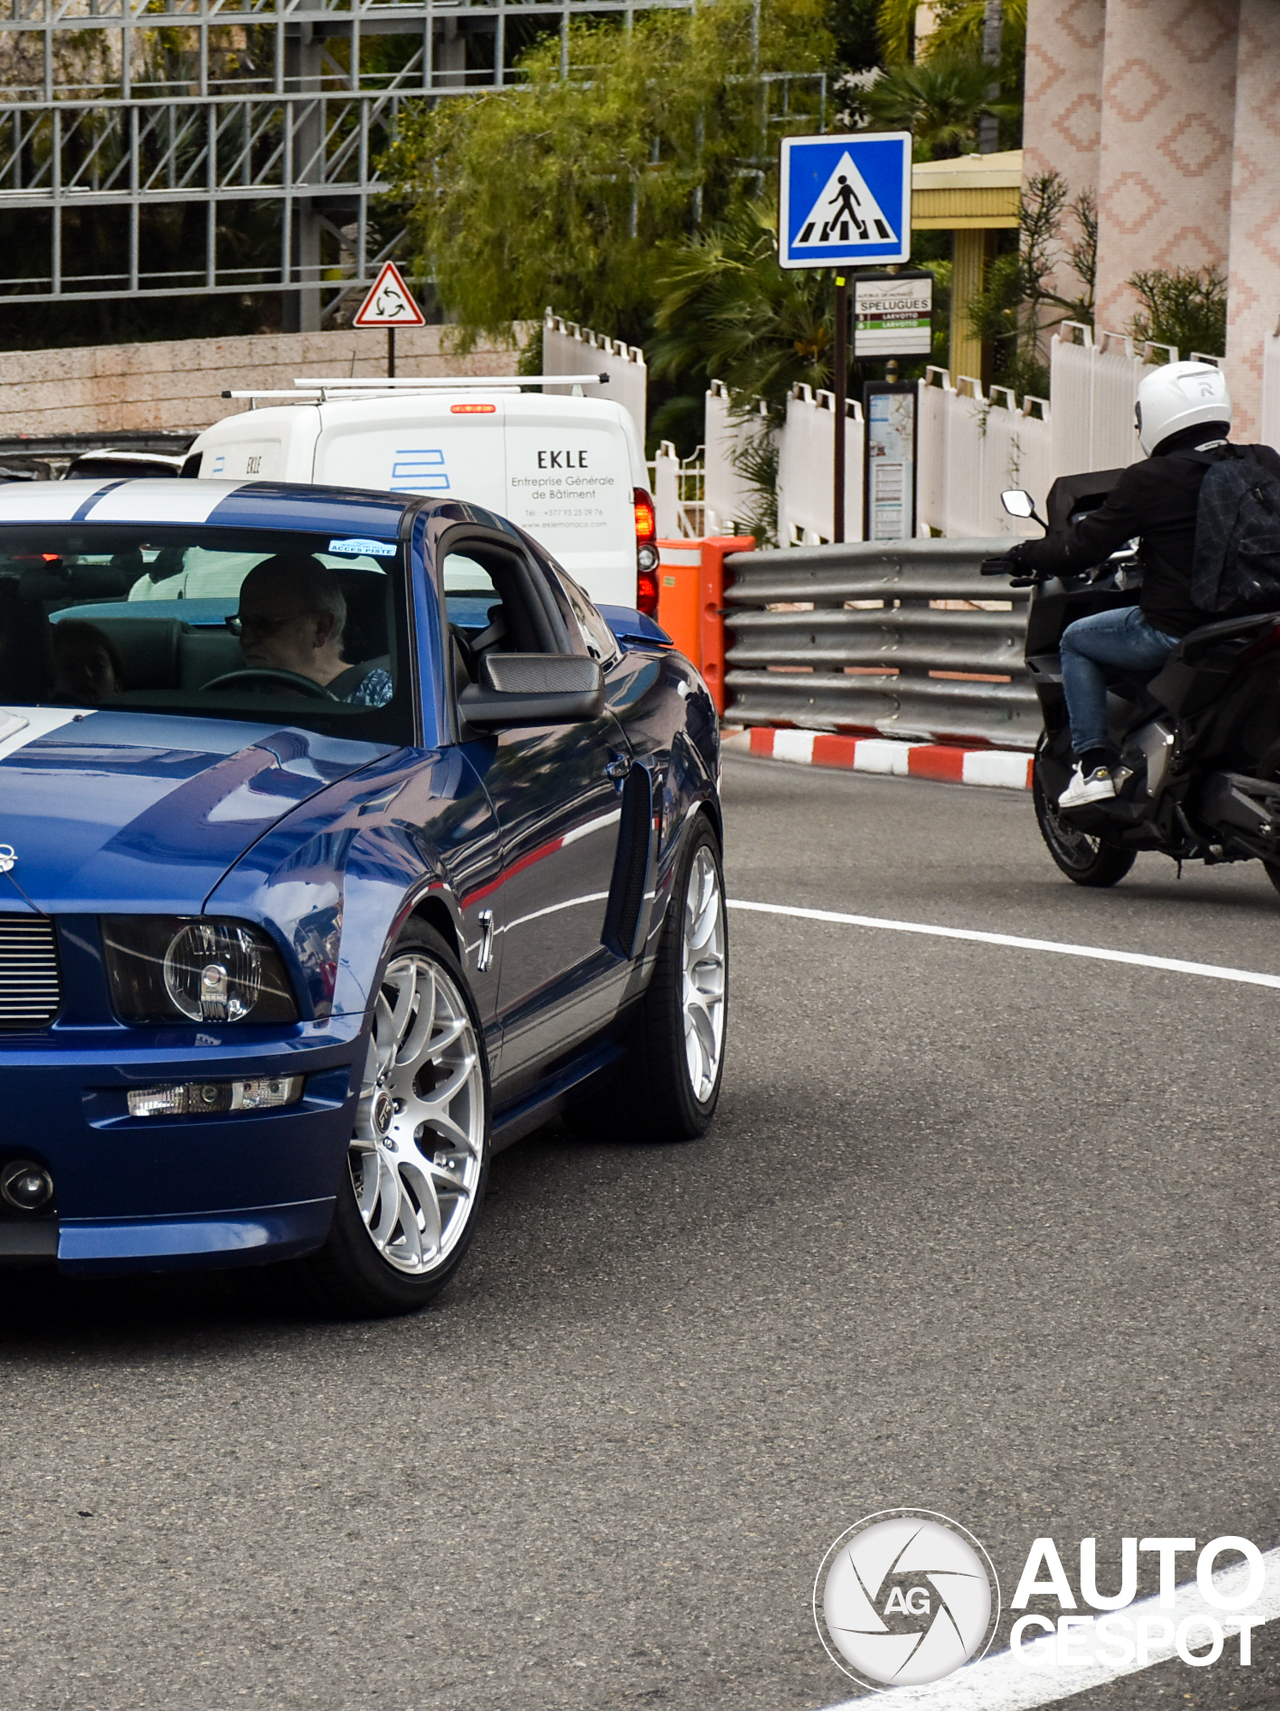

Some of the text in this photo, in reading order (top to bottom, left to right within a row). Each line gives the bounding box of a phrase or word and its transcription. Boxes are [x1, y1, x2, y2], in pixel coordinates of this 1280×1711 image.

[861, 300, 928, 311] SPELUGUES
[882, 312, 919, 320] LARVOTTO
[246, 455, 262, 474] EKLE
[537, 450, 588, 469] EKLE
[511, 476, 615, 487] Entreprise Générale
[532, 489, 596, 499] de Bâtiment
[564, 508, 572, 516] 93
